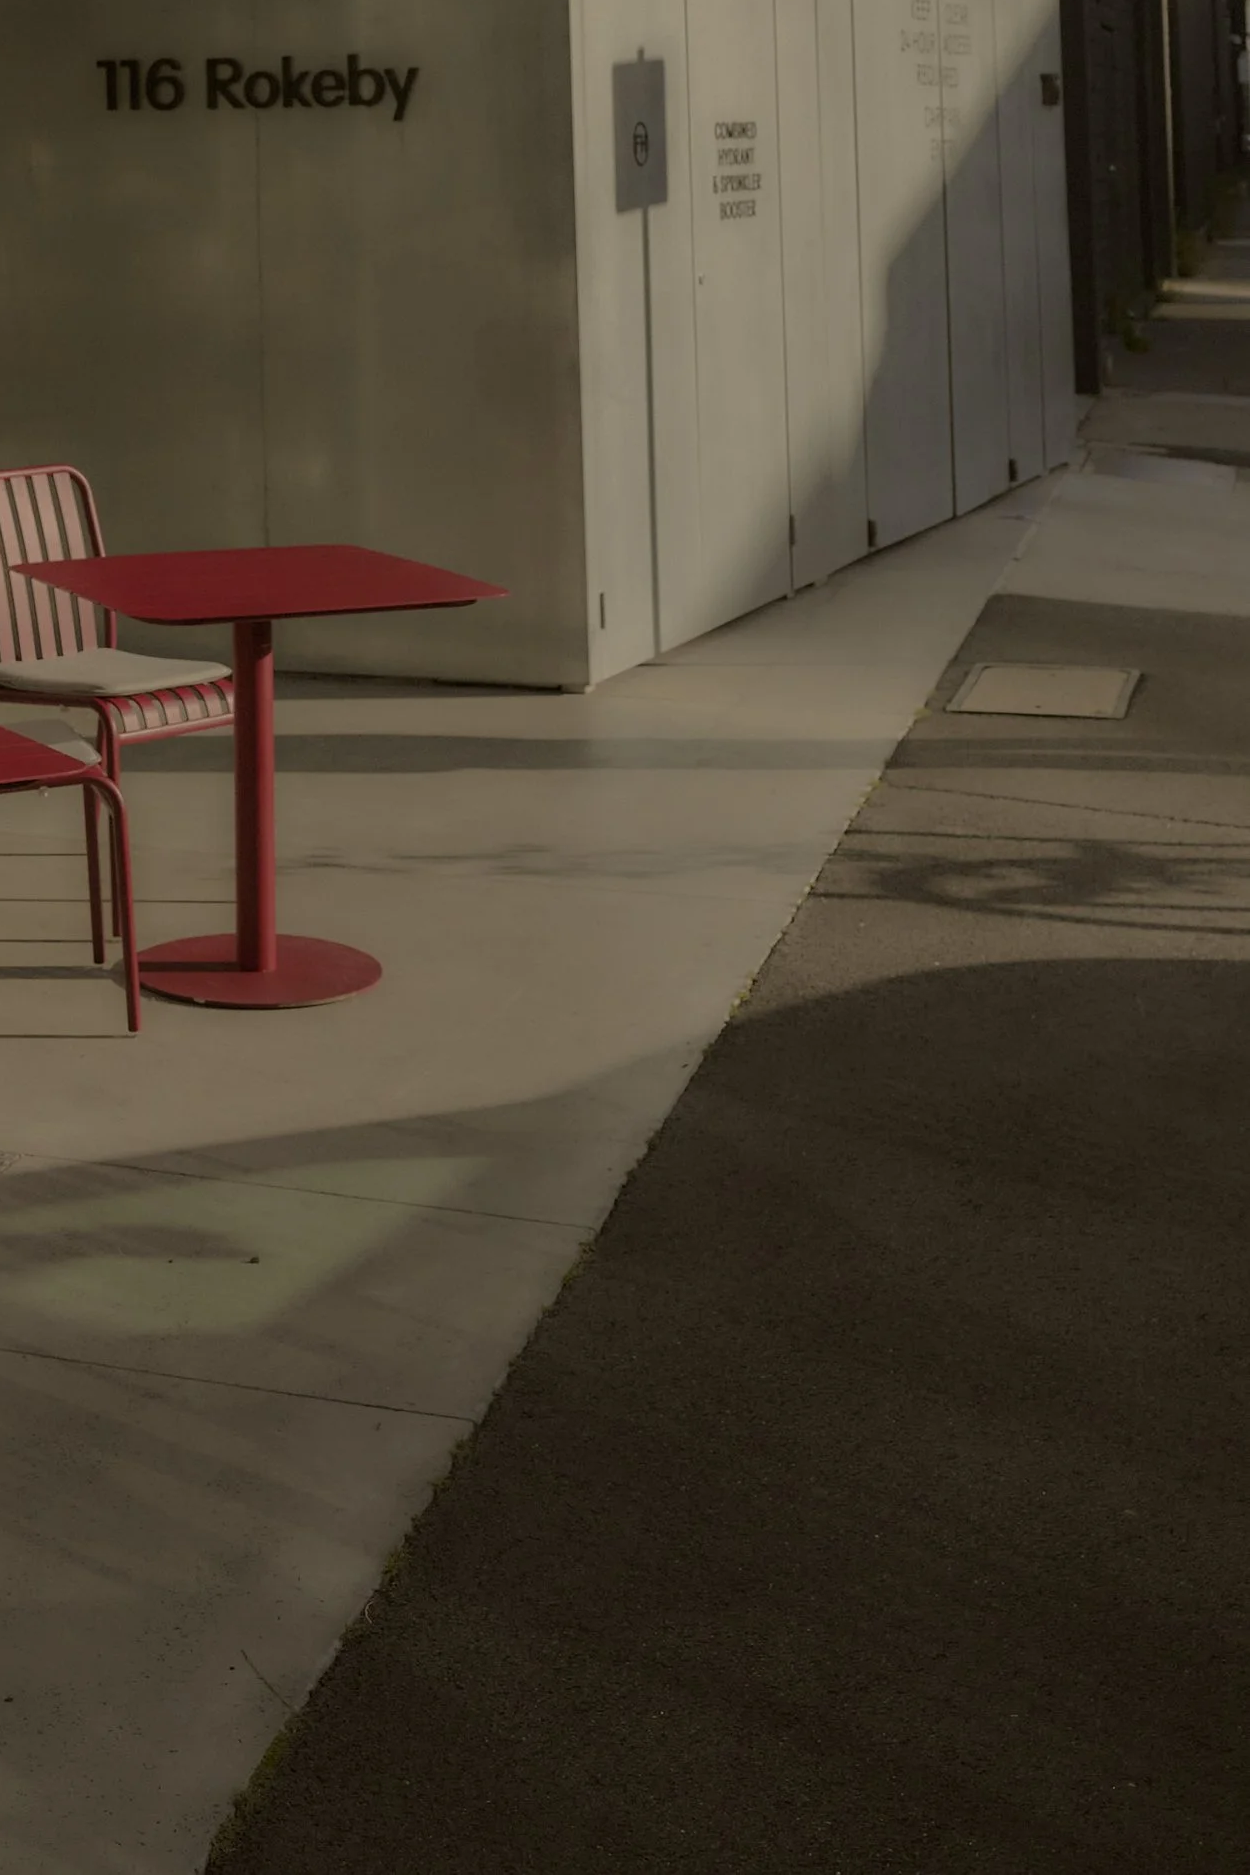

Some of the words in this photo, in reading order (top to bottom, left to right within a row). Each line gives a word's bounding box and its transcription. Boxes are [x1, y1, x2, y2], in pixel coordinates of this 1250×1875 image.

[96, 58, 184, 111] 116
[206, 54, 419, 122] Rokeby
[714, 121, 757, 139] COMBINED
[718, 148, 755, 166] HYDRANT
[720, 173, 762, 193] SPRINKLER
